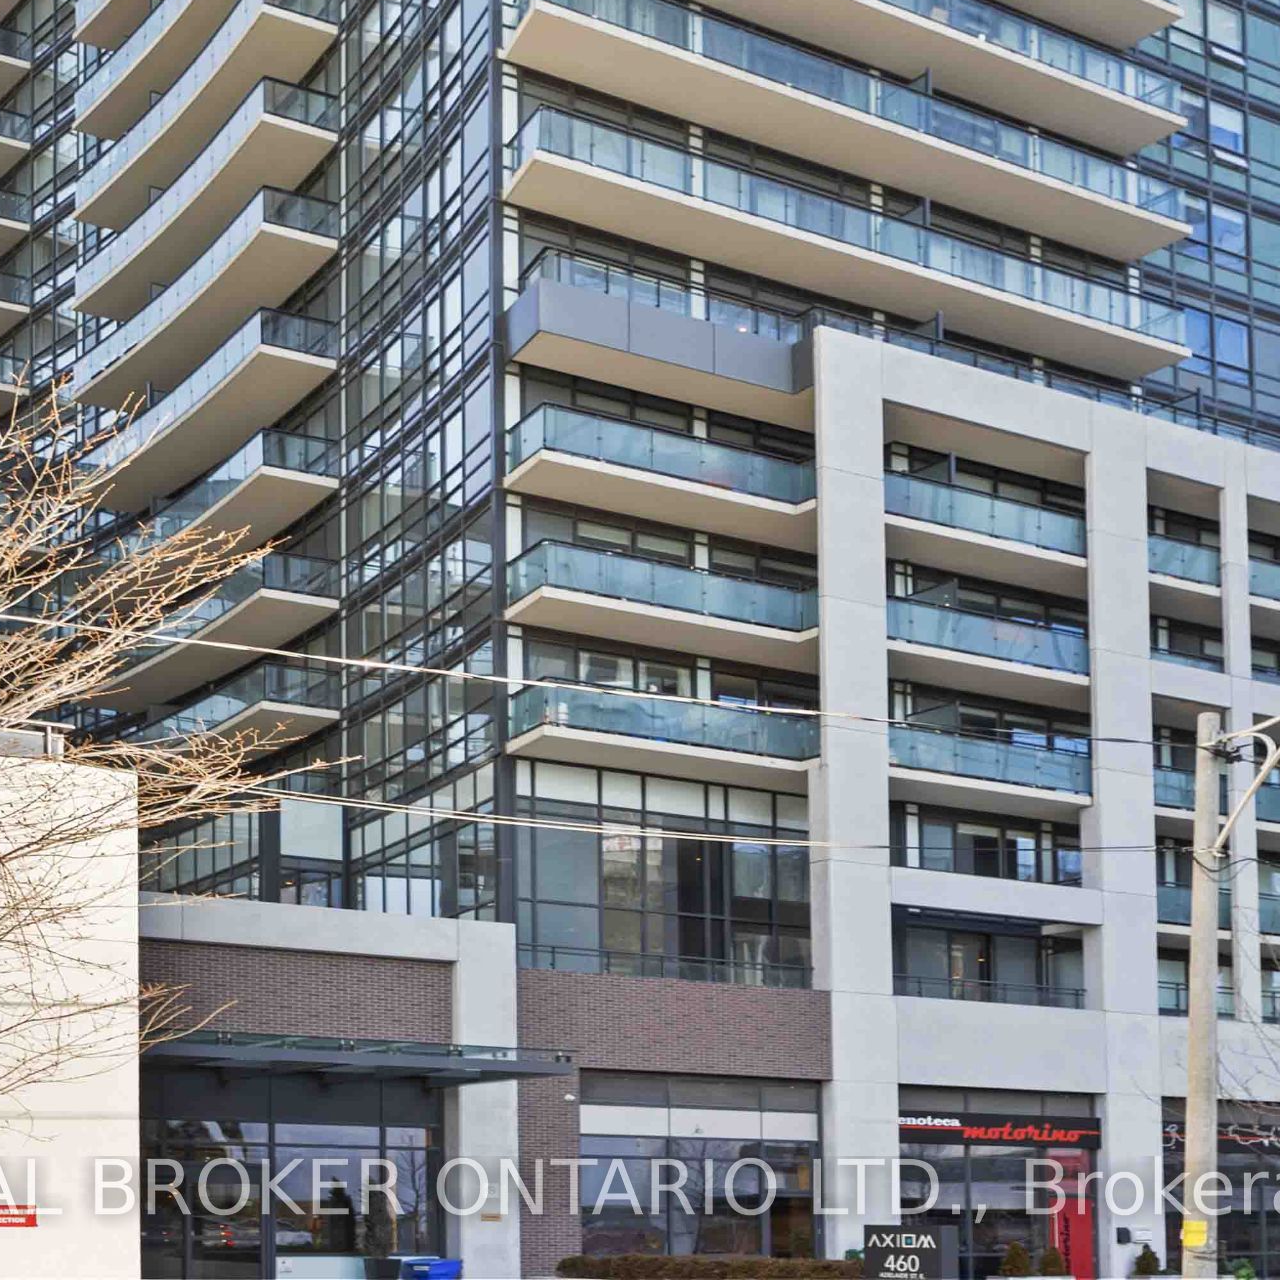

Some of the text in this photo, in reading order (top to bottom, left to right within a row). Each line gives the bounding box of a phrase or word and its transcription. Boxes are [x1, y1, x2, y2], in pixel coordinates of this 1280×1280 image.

[898, 1115, 962, 1127] enoteca
[963, 1121, 1081, 1143] motorino
[867, 1233, 937, 1249] AXIOM
[883, 1254, 920, 1272] 460
